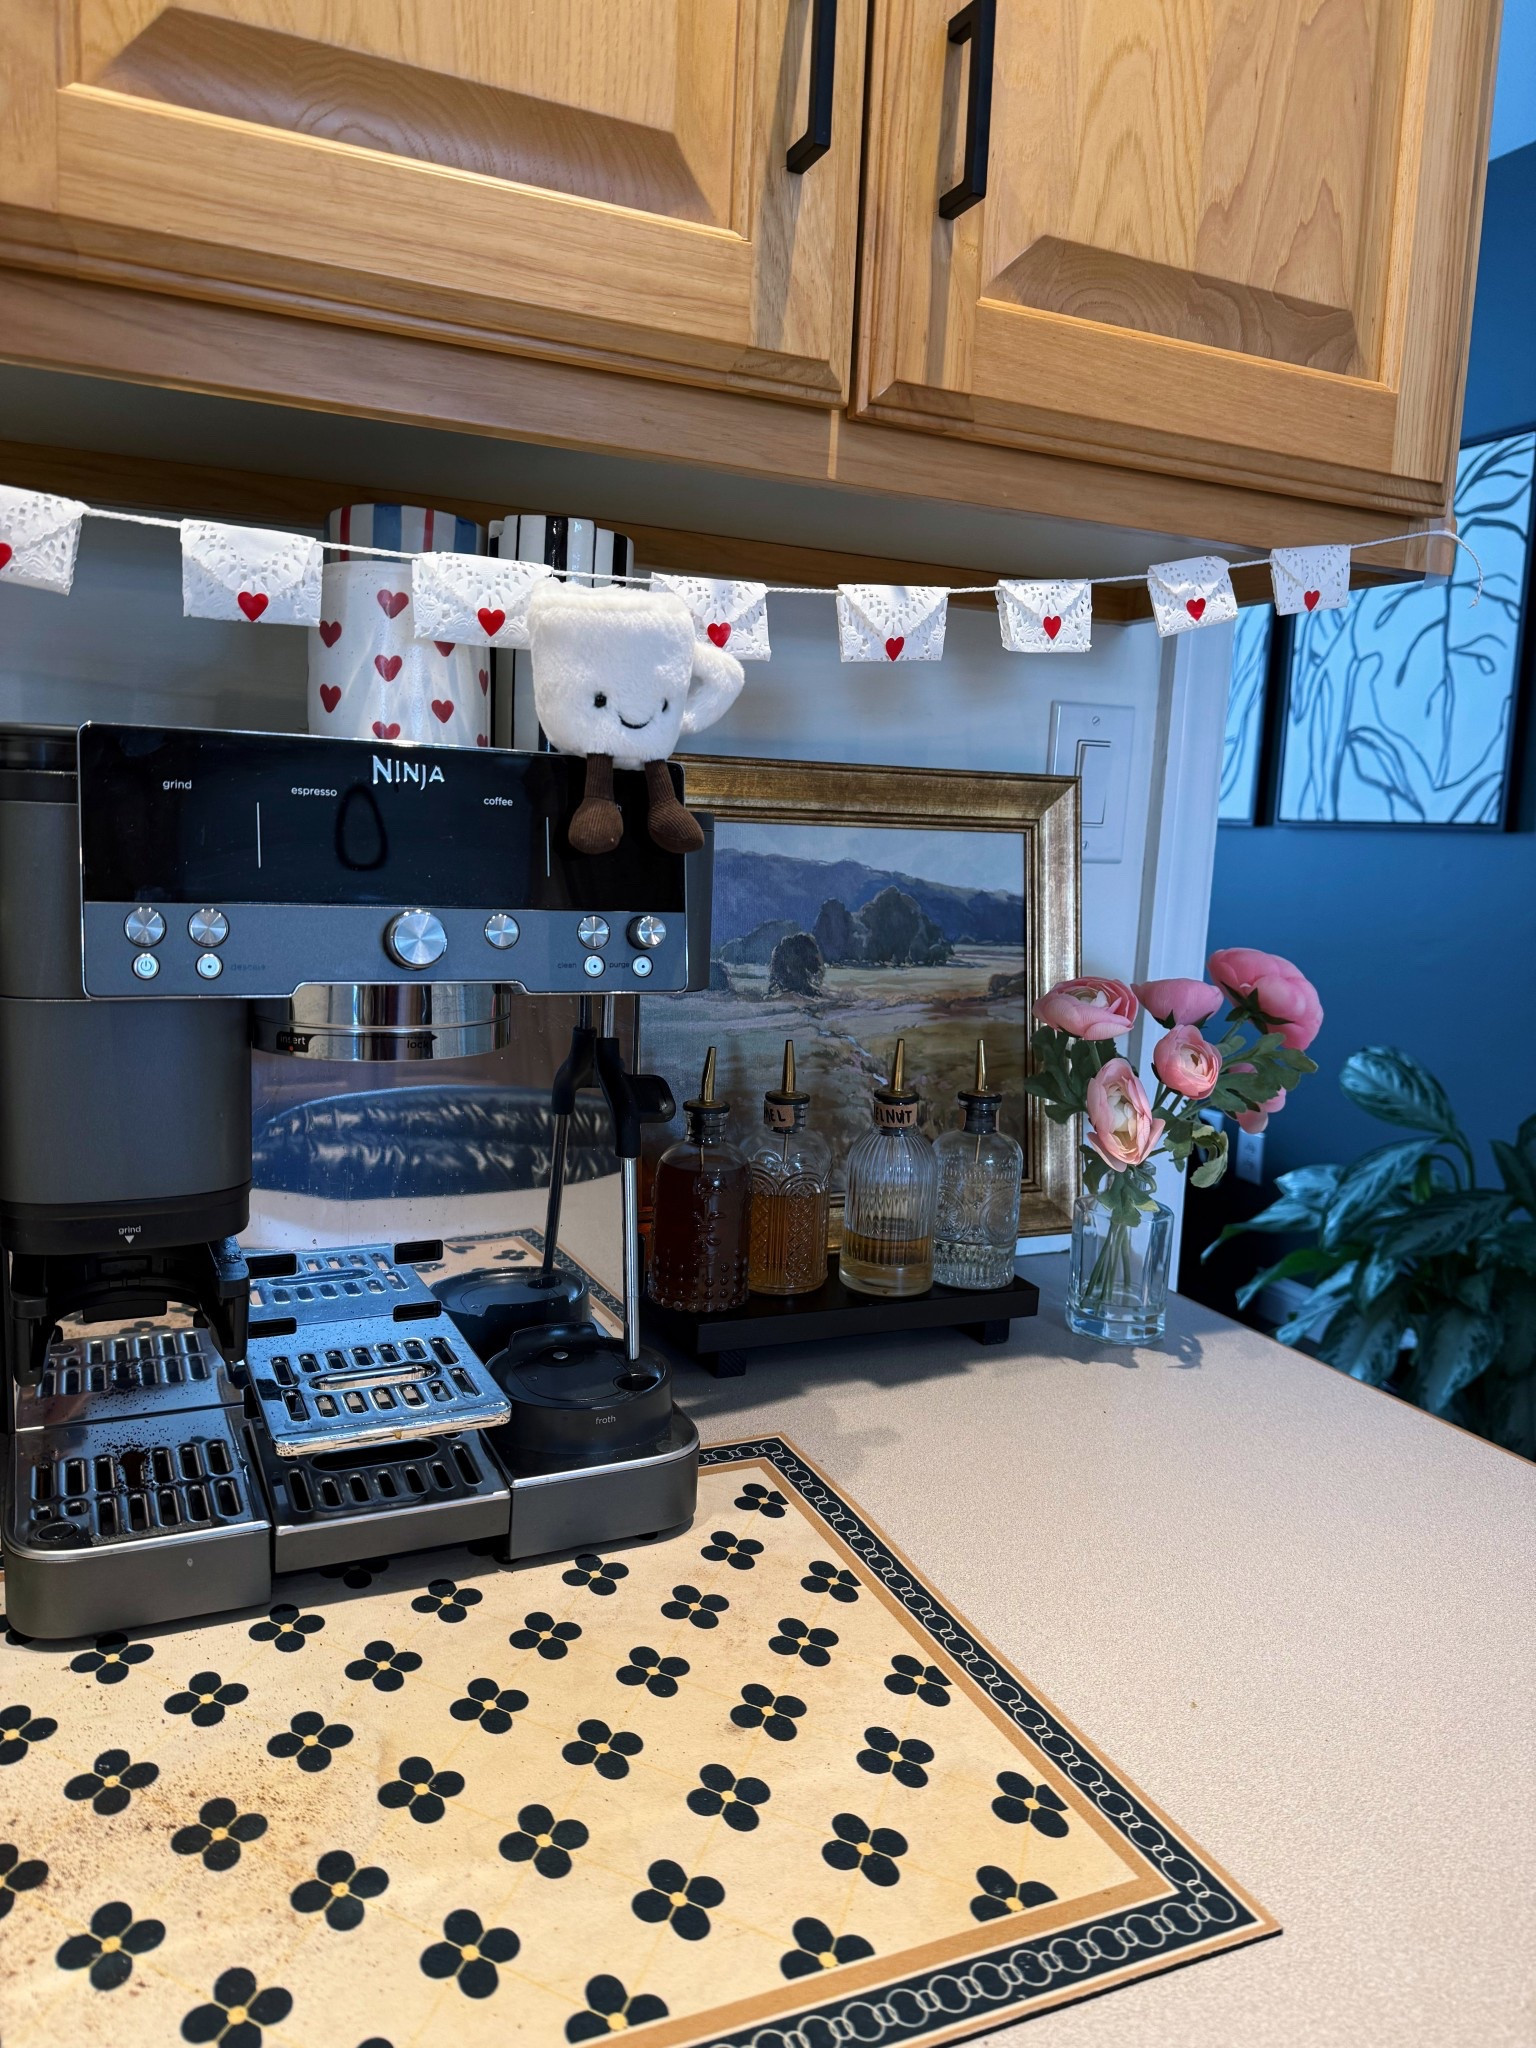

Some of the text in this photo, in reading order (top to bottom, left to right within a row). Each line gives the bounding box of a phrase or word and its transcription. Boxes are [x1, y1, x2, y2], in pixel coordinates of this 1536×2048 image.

[371, 754, 446, 791] NINJA
[162, 779, 192, 790] grind
[290, 786, 338, 797] espresso
[483, 796, 514, 807] coffee
[557, 961, 577, 969] clean
[608, 961, 630, 969] purge
[280, 1035, 306, 1046] insert
[406, 1039, 430, 1049] lock
[118, 1225, 142, 1235] grind
[595, 1414, 617, 1425] froth
